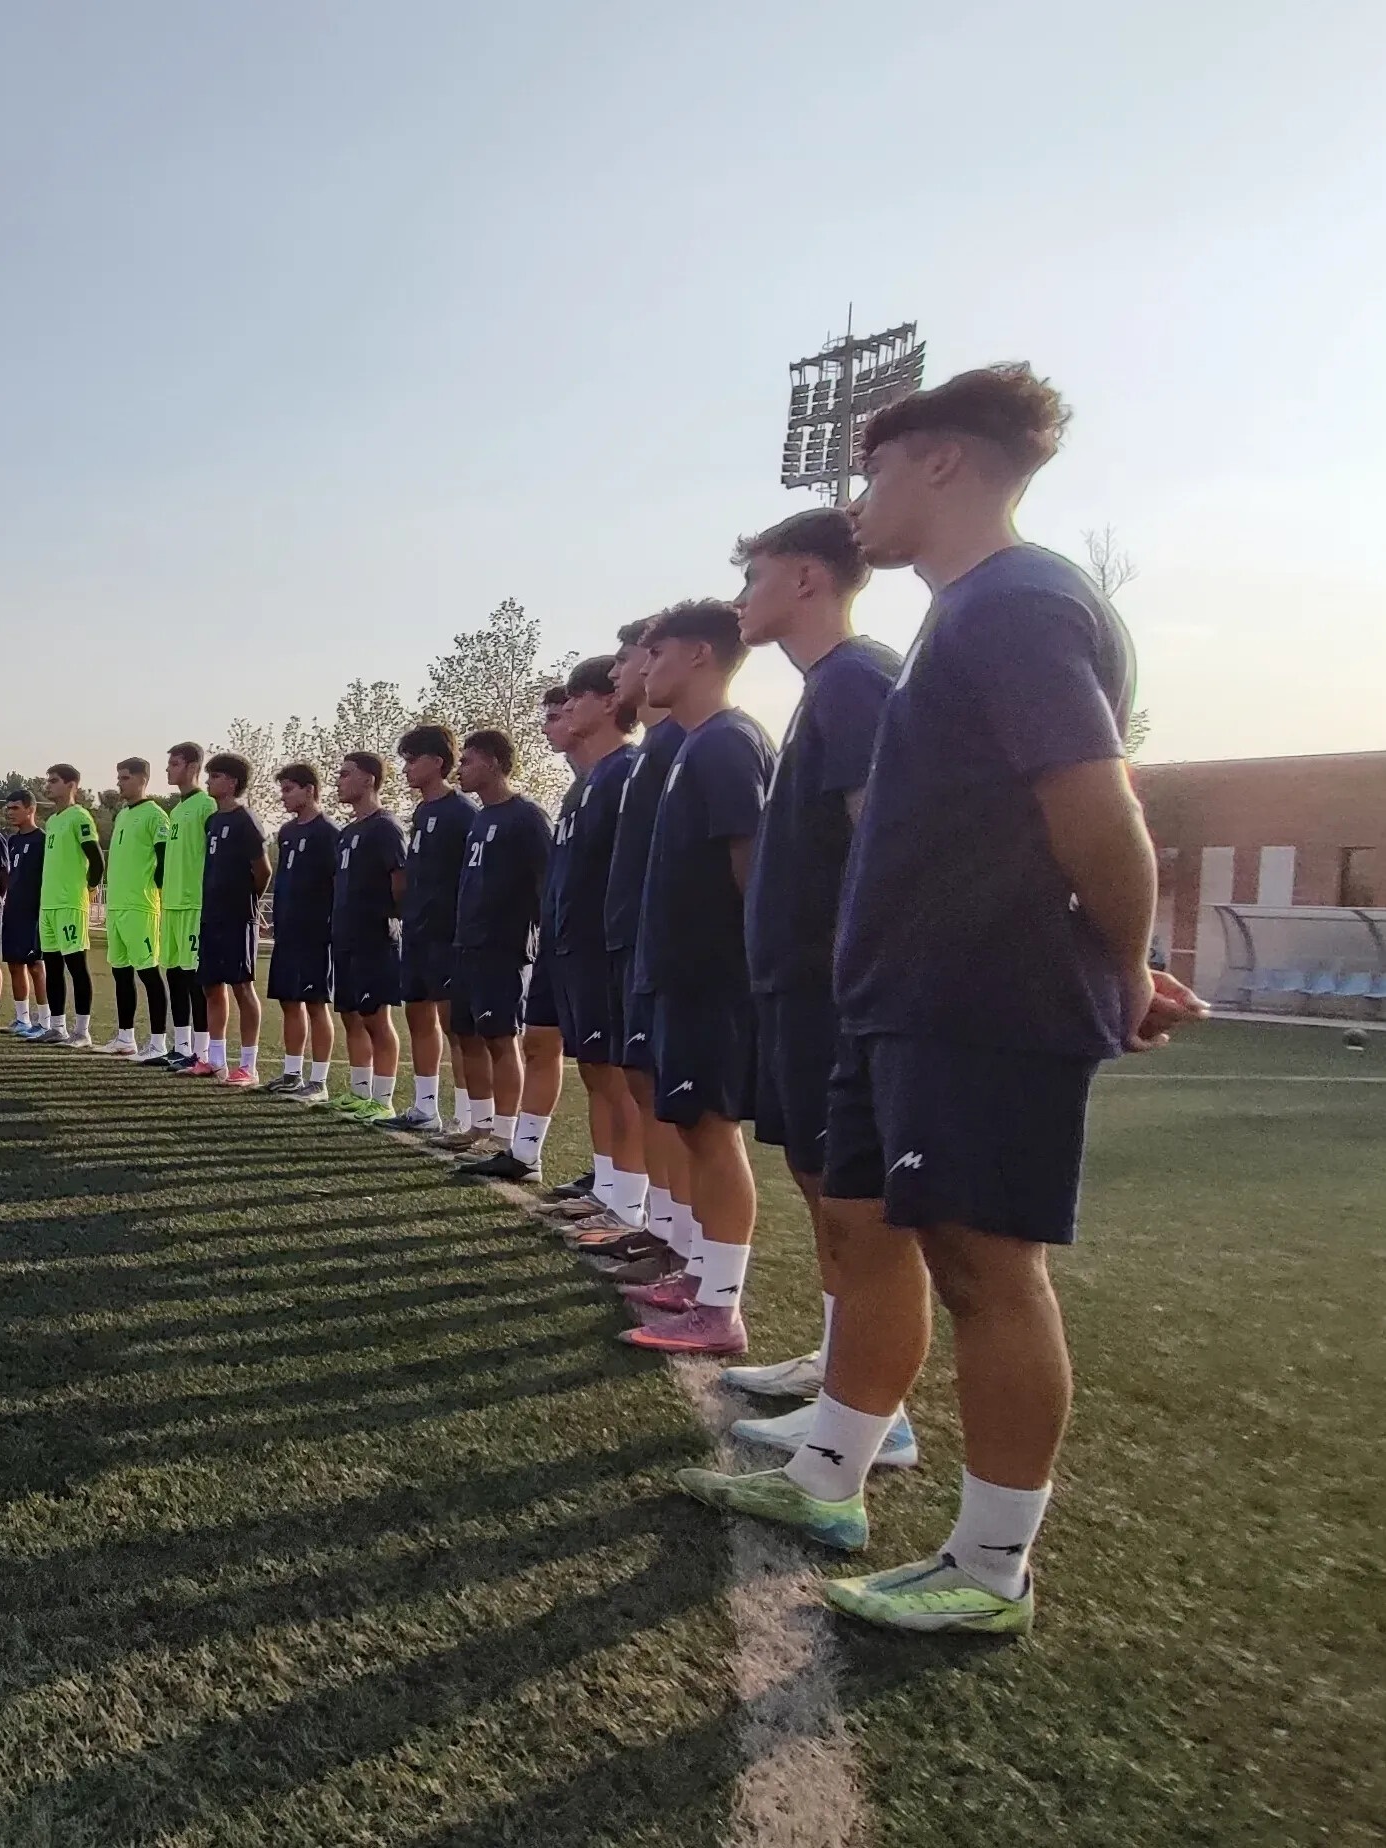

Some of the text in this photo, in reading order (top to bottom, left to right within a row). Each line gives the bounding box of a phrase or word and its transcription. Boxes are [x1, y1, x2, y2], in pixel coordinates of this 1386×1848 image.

[118, 829, 124, 845] 1
[170, 823, 179, 841] 22
[209, 836, 217, 855] 5
[468, 841, 484, 867] 21
[13, 853, 20, 868] 8
[287, 850, 295, 869] 9
[62, 924, 77, 942] 12
[144, 937, 152, 953] 1
[189, 934, 201, 952] 2
